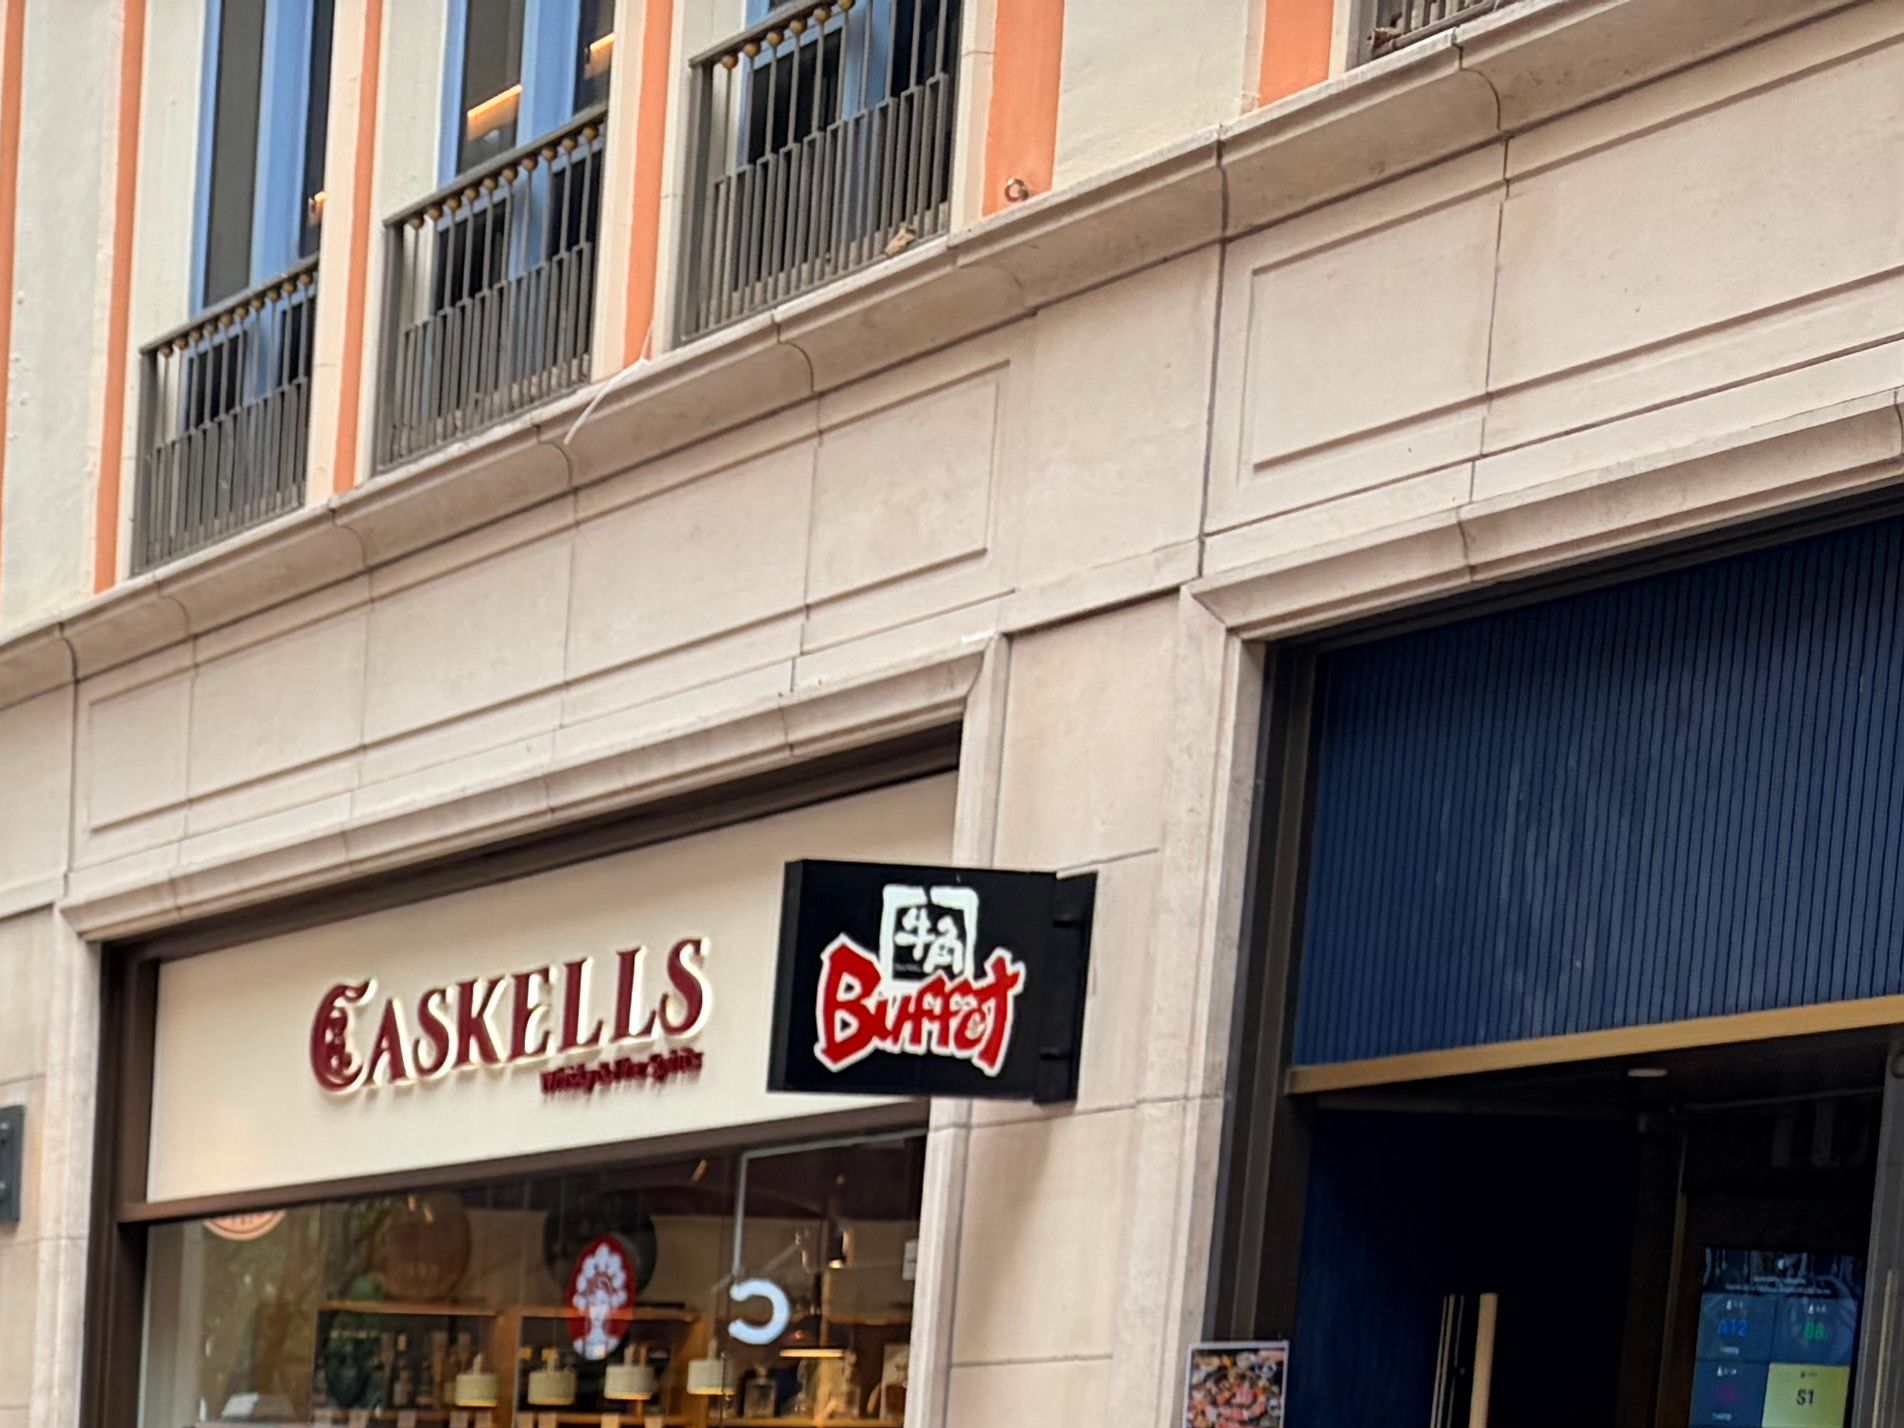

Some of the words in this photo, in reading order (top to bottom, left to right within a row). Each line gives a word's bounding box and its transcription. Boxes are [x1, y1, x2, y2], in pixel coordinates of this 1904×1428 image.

[894, 906, 964, 973] 牛角
[310, 937, 706, 1094] CASKELLS
[814, 932, 1025, 1077] Buffet
[1796, 1389, 1815, 1406] S1
